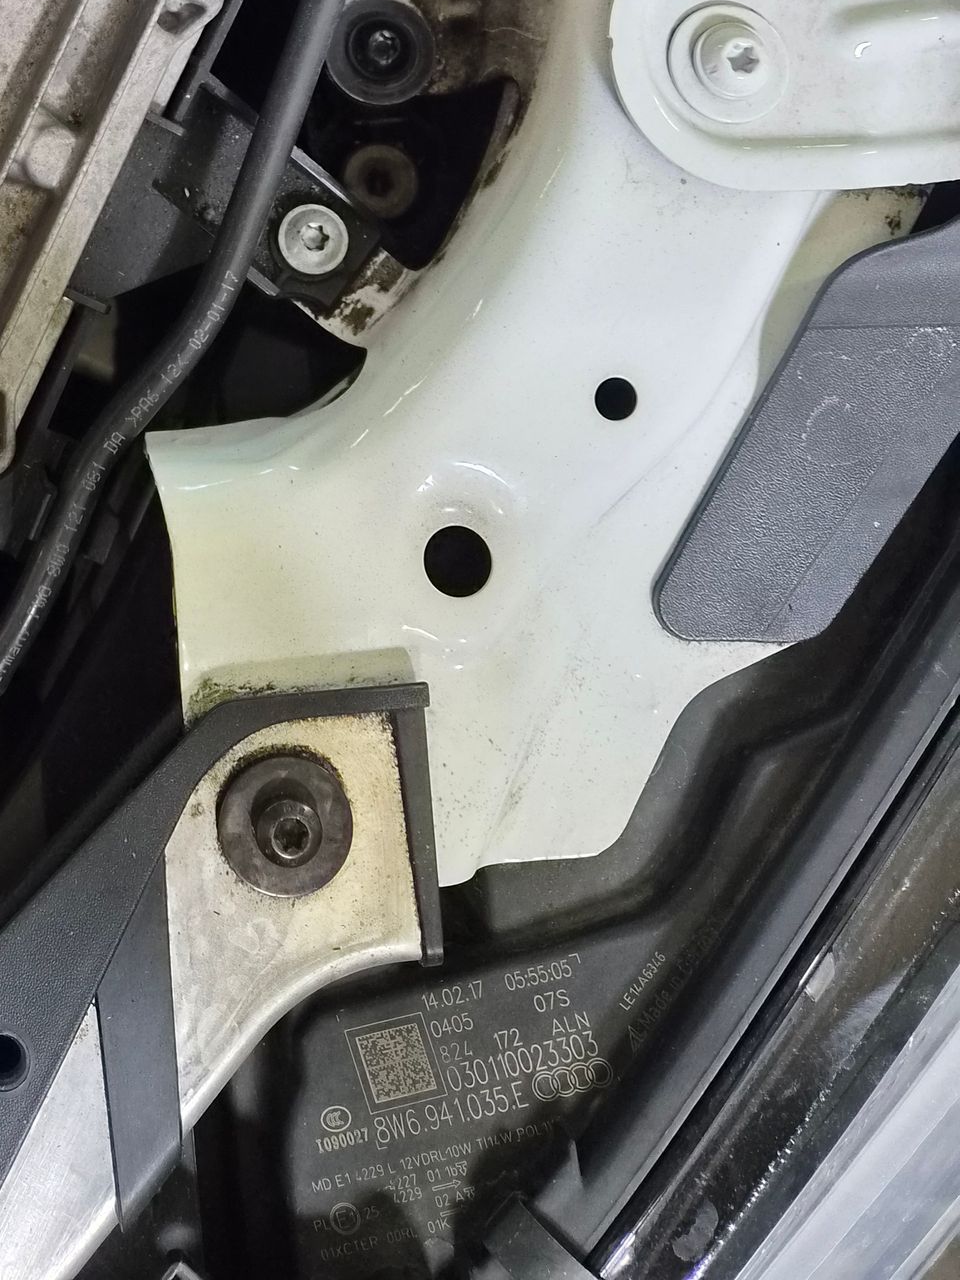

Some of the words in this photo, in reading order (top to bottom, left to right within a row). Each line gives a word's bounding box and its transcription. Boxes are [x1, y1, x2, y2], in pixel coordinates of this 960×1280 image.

[103, 431, 127, 455] DA
[189, 270, 239, 349] 02-01-17
[421, 980, 484, 1011] 14.02.17
[504, 960, 573, 991] 05:55:05
[619, 951, 666, 1011] LE14A6346
[430, 1013, 474, 1038] 0405
[533, 989, 571, 1012] 07S
[440, 1041, 473, 1063] 824
[493, 1028, 524, 1050] 172
[551, 1012, 591, 1036] ALN
[446, 1031, 599, 1092] 030110023303
[374, 1081, 529, 1144] 8W6.941.035.E
[311, 1178, 333, 1193] MD
[335, 1172, 352, 1187] E1
[388, 1162, 396, 1175] L
[435, 1194, 450, 1208] 02
[313, 1218, 331, 1233] PL
